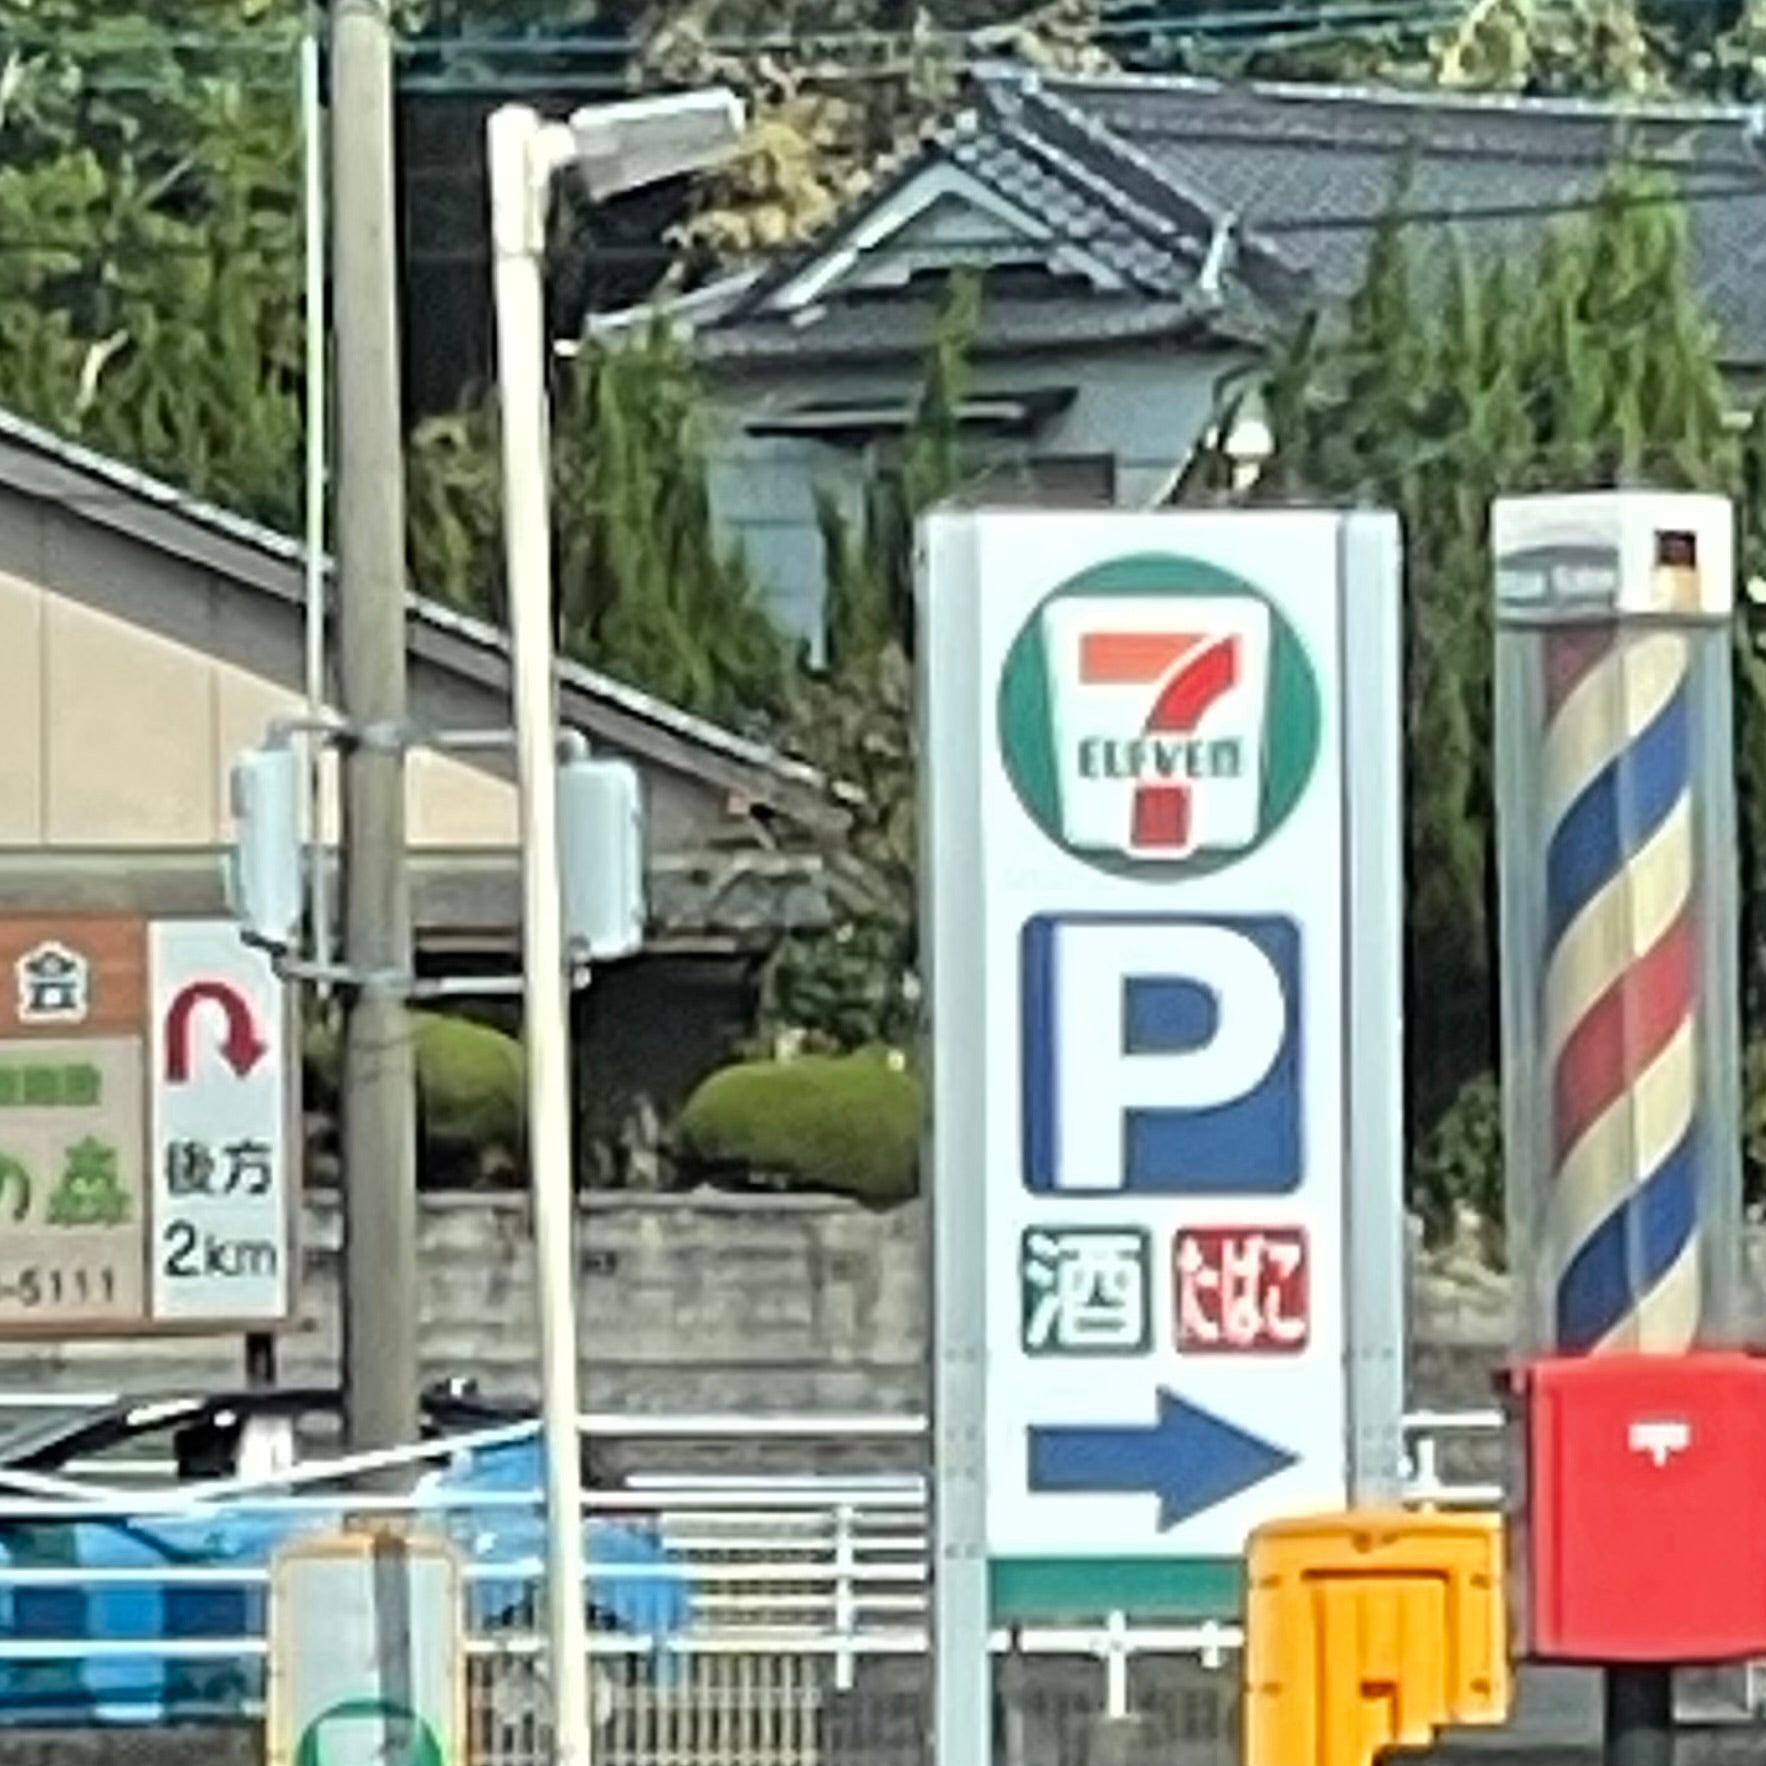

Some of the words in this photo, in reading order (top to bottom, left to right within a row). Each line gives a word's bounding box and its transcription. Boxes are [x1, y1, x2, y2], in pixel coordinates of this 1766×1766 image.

[1078, 631, 1239, 847] 7
[1054, 923, 1286, 1190] P
[164, 1139, 273, 1195] 後方
[163, 1218, 278, 1278] 2km
[1026, 1232, 1143, 1348] 酒
[1176, 1234, 1306, 1345] たばこ
